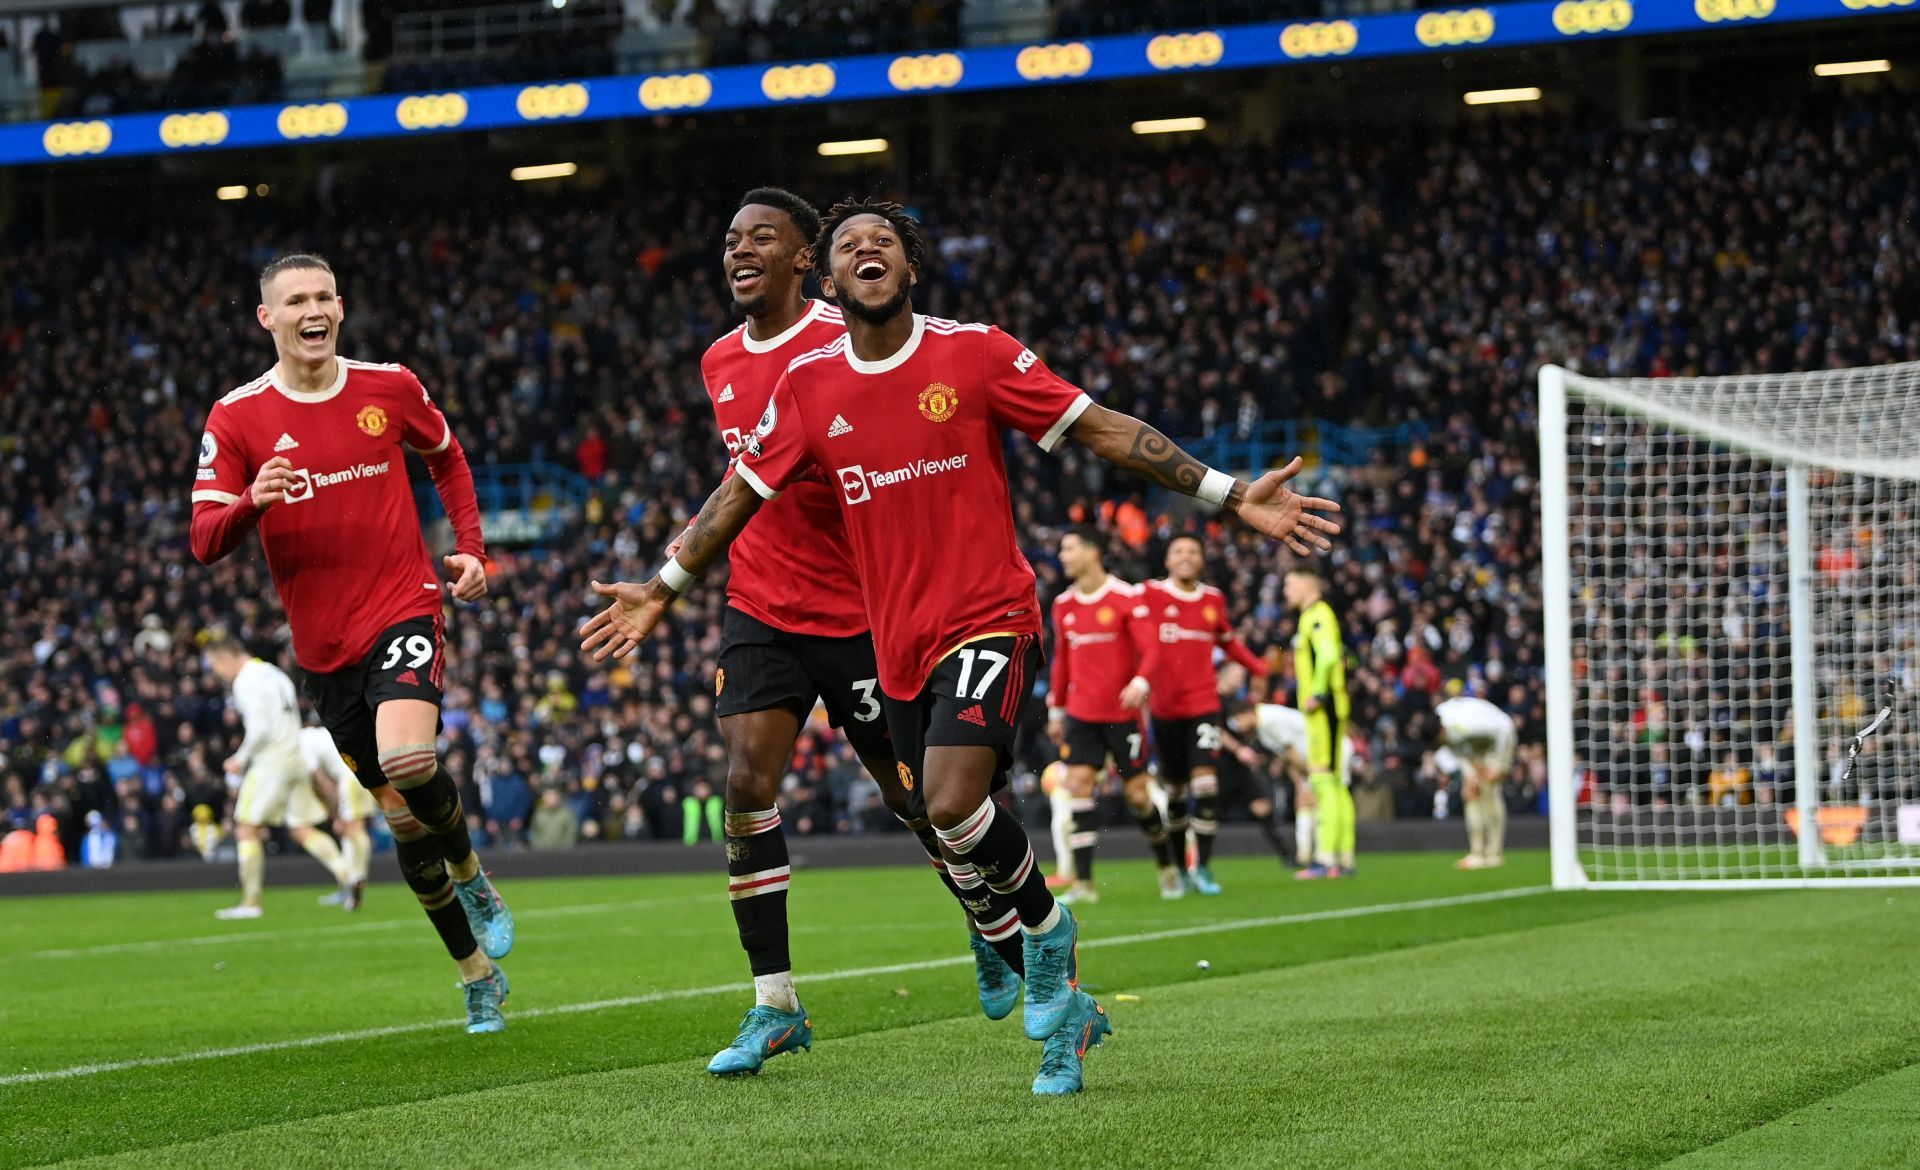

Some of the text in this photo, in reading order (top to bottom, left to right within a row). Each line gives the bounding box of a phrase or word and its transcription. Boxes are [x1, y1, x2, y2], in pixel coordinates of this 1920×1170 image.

[827, 425, 854, 438] adidas
[311, 461, 390, 488] TeamViewer
[866, 453, 968, 488] TeamViewer
[955, 648, 1010, 700] 17
